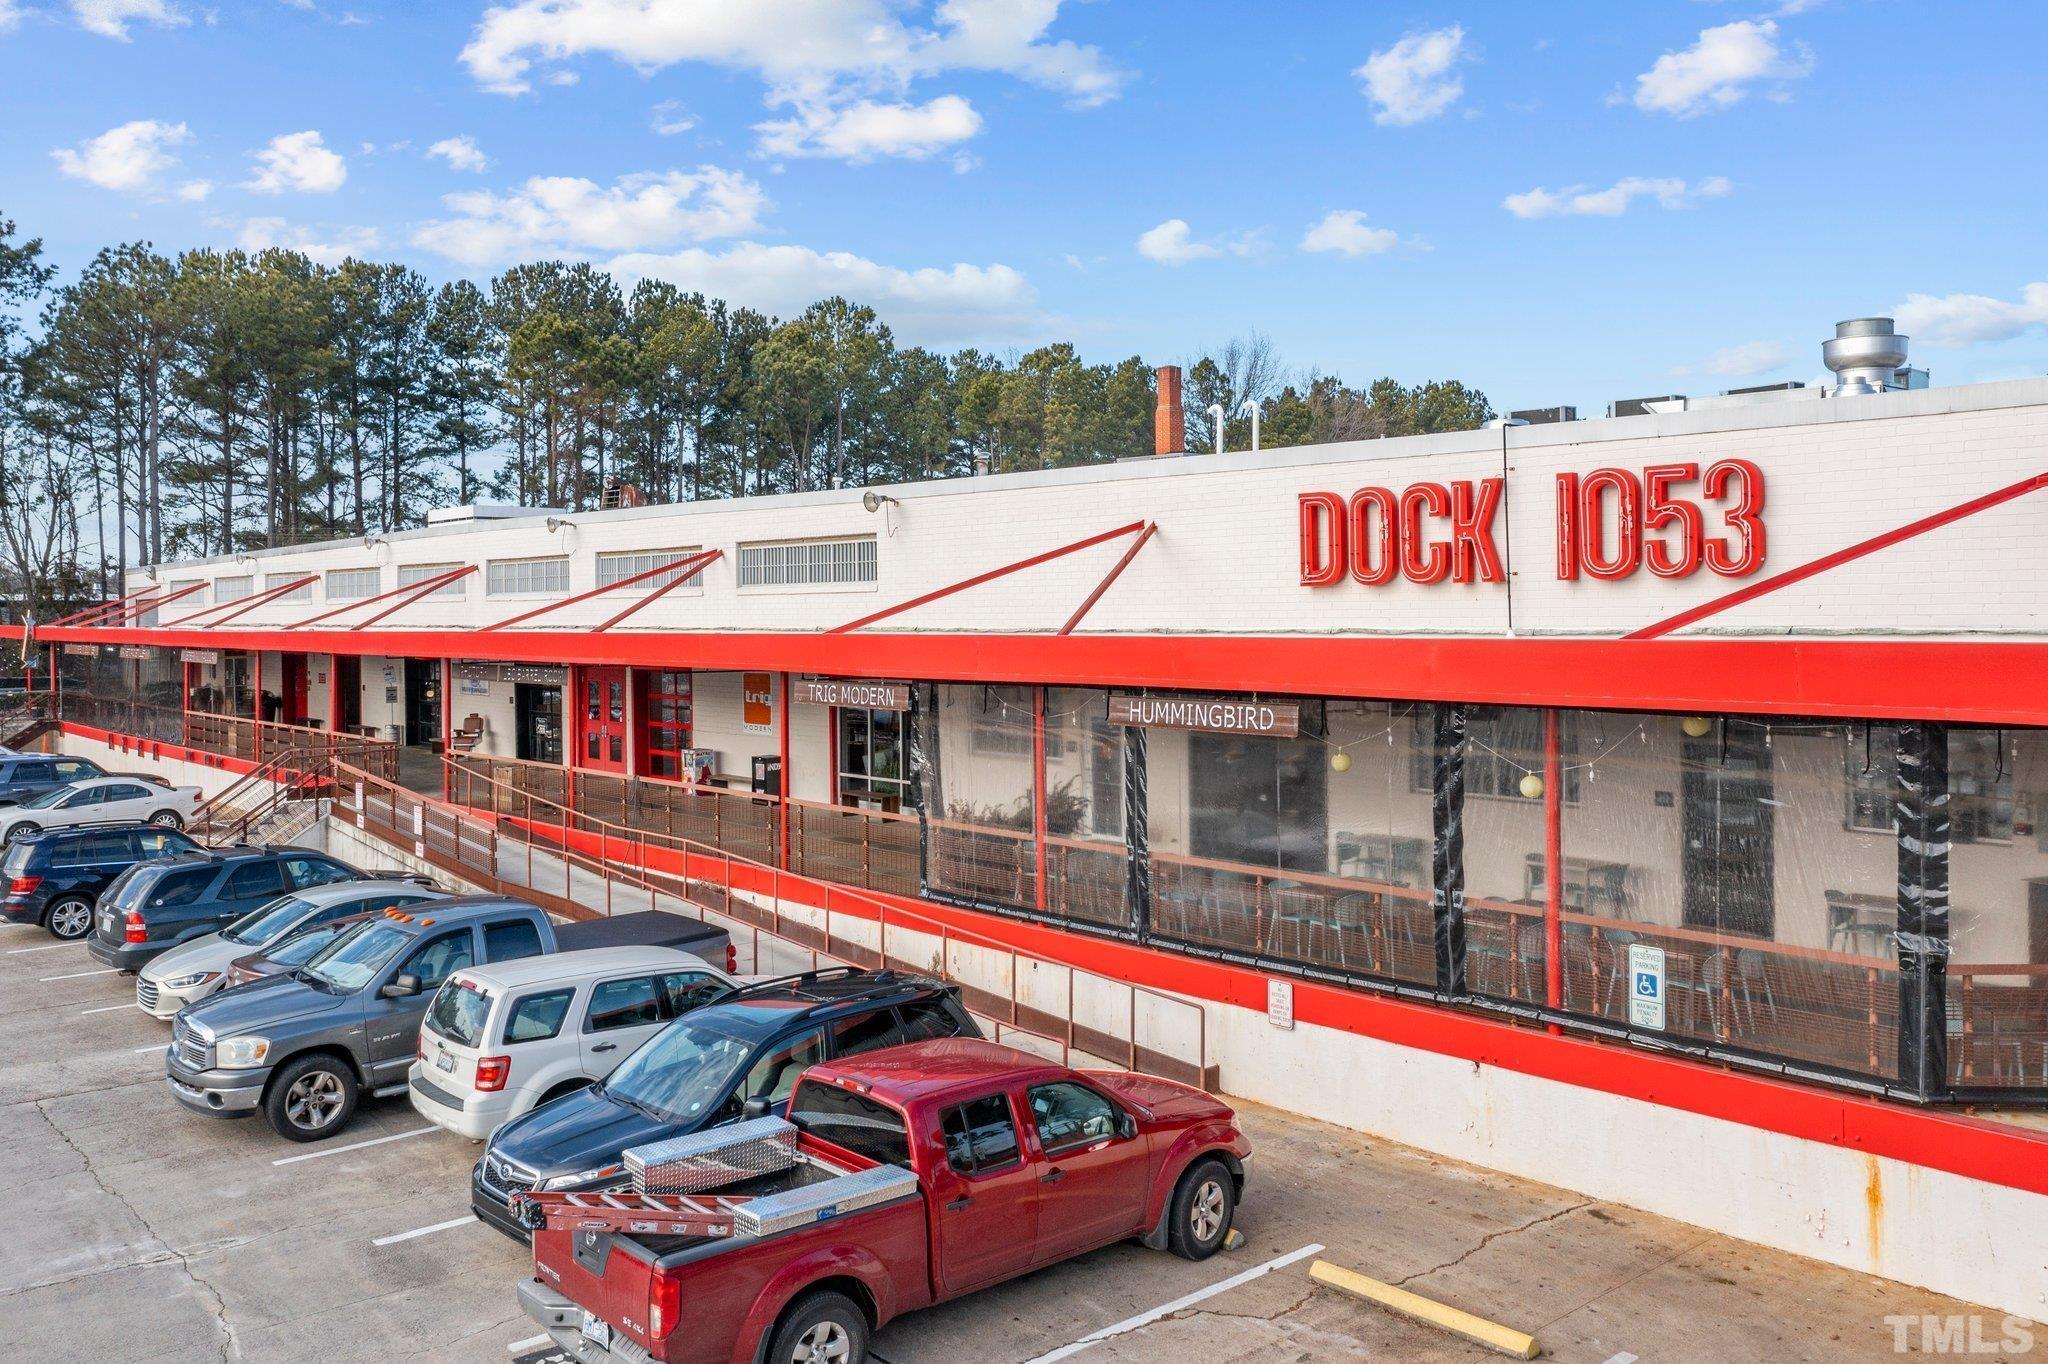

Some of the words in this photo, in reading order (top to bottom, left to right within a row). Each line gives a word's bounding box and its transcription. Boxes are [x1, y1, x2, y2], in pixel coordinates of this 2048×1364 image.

[1299, 477, 1505, 587] DOCK
[1556, 458, 1767, 581] 1053
[745, 691, 772, 706] trig
[808, 684, 837, 703] TRIG
[841, 686, 895, 706] MODERN
[1129, 701, 1274, 730] HUMMINGBIRD
[1633, 951, 1661, 962] RESERVED
[1635, 961, 1659, 971] PARKING
[373, 1032, 401, 1043] RAM
[537, 1260, 560, 1283] FRONTIER
[622, 1316, 632, 1327] SE
